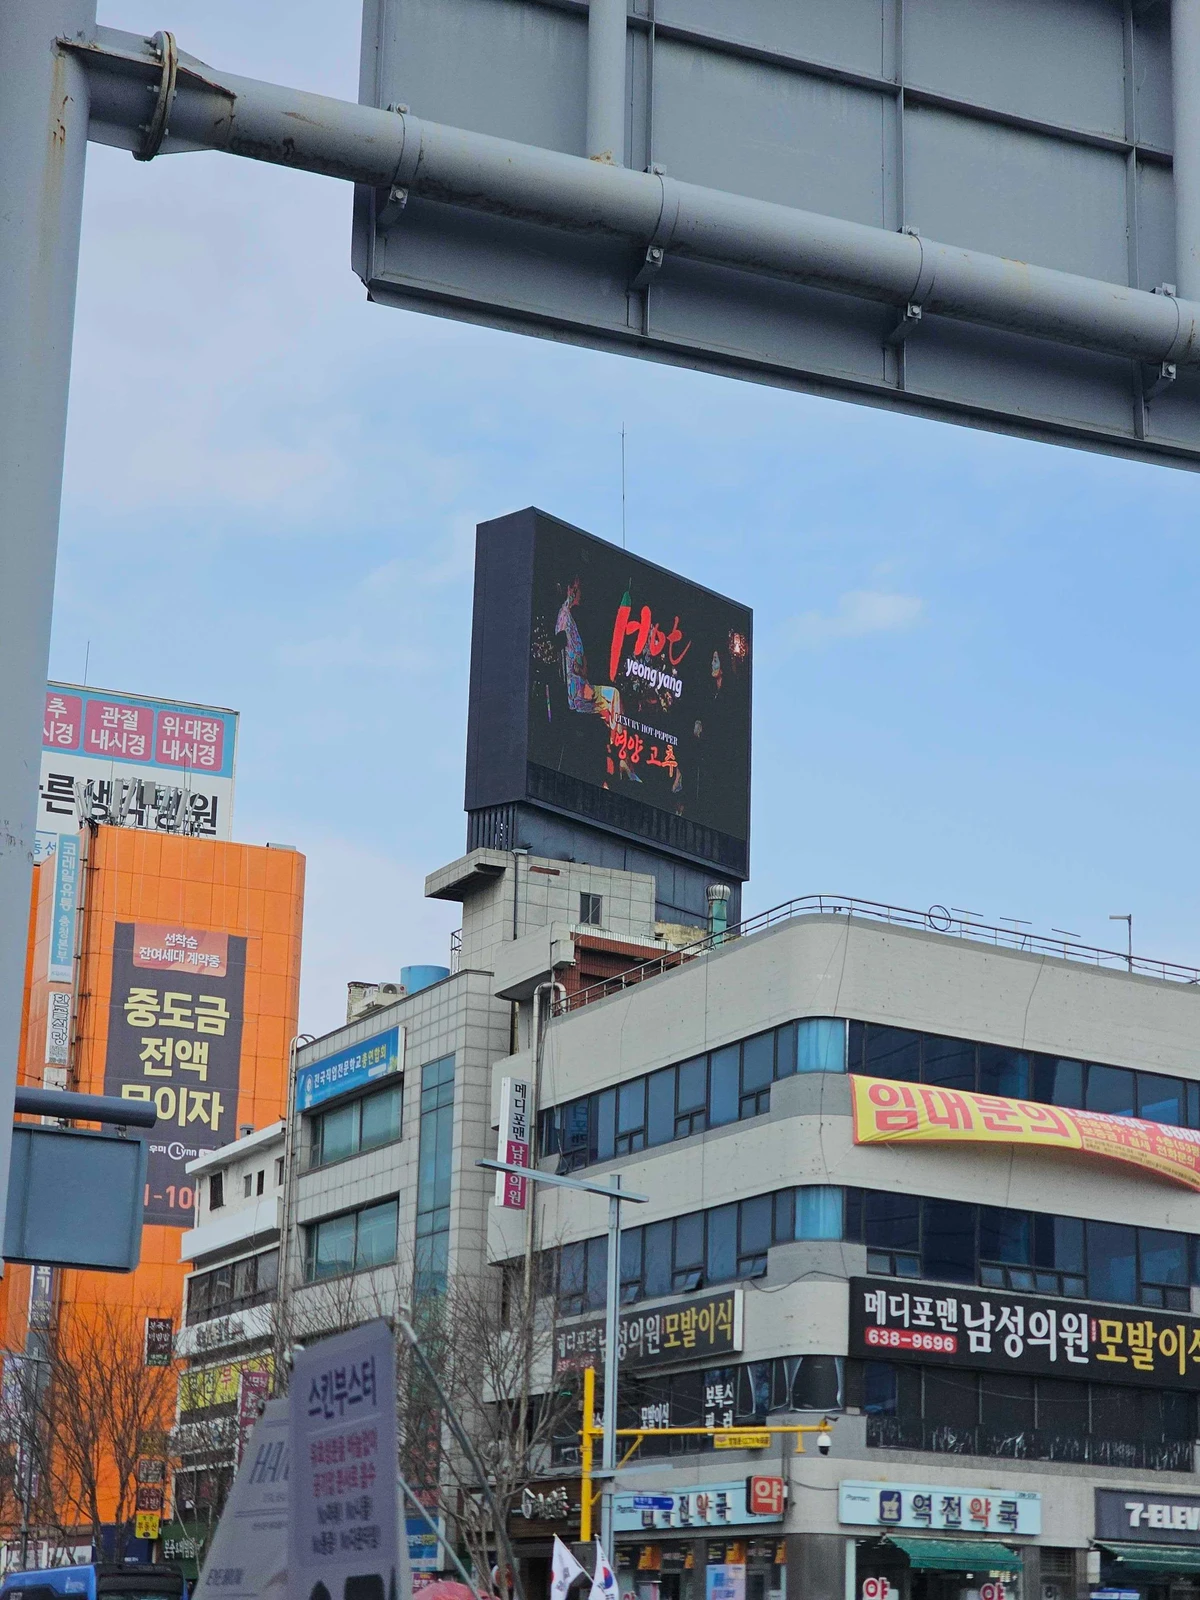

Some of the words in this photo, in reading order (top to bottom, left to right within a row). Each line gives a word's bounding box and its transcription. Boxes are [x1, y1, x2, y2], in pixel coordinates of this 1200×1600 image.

[609, 588, 691, 682] Hot
[625, 658, 657, 687] yeong
[657, 671, 682, 698] yang
[47, 697, 68, 719] 추
[100, 705, 139, 731] 관절
[91, 728, 145, 756] 내시경
[641, 723, 654, 736] HOT
[654, 729, 678, 746] PEPPER
[162, 739, 215, 766] 내시경
[614, 730, 643, 763] 영양
[646, 744, 678, 778] 고추
[40, 772, 218, 836] 른생각병원
[139, 947, 185, 964] 잔여세대
[186, 951, 221, 968] 계약중
[164, 932, 198, 950] 선착순
[123, 987, 230, 1036] 중도금
[139, 1037, 210, 1082] 전액
[512, 1083, 527, 1142] 메디포맨
[867, 1083, 1072, 1139] 임대문의
[149, 1145, 167, 1154] 우미
[663, 1298, 733, 1349] 모발이식
[863, 1289, 958, 1333] 메디포맨
[961, 1301, 1090, 1364] 남성의원
[867, 1329, 955, 1353] 638-9696
[308, 1356, 377, 1419] 스킨부스터
[705, 1382, 734, 1408] 보톡스
[641, 1402, 670, 1430] 모발이식
[754, 1479, 783, 1512] 약
[911, 1492, 1019, 1530] 역전약국
